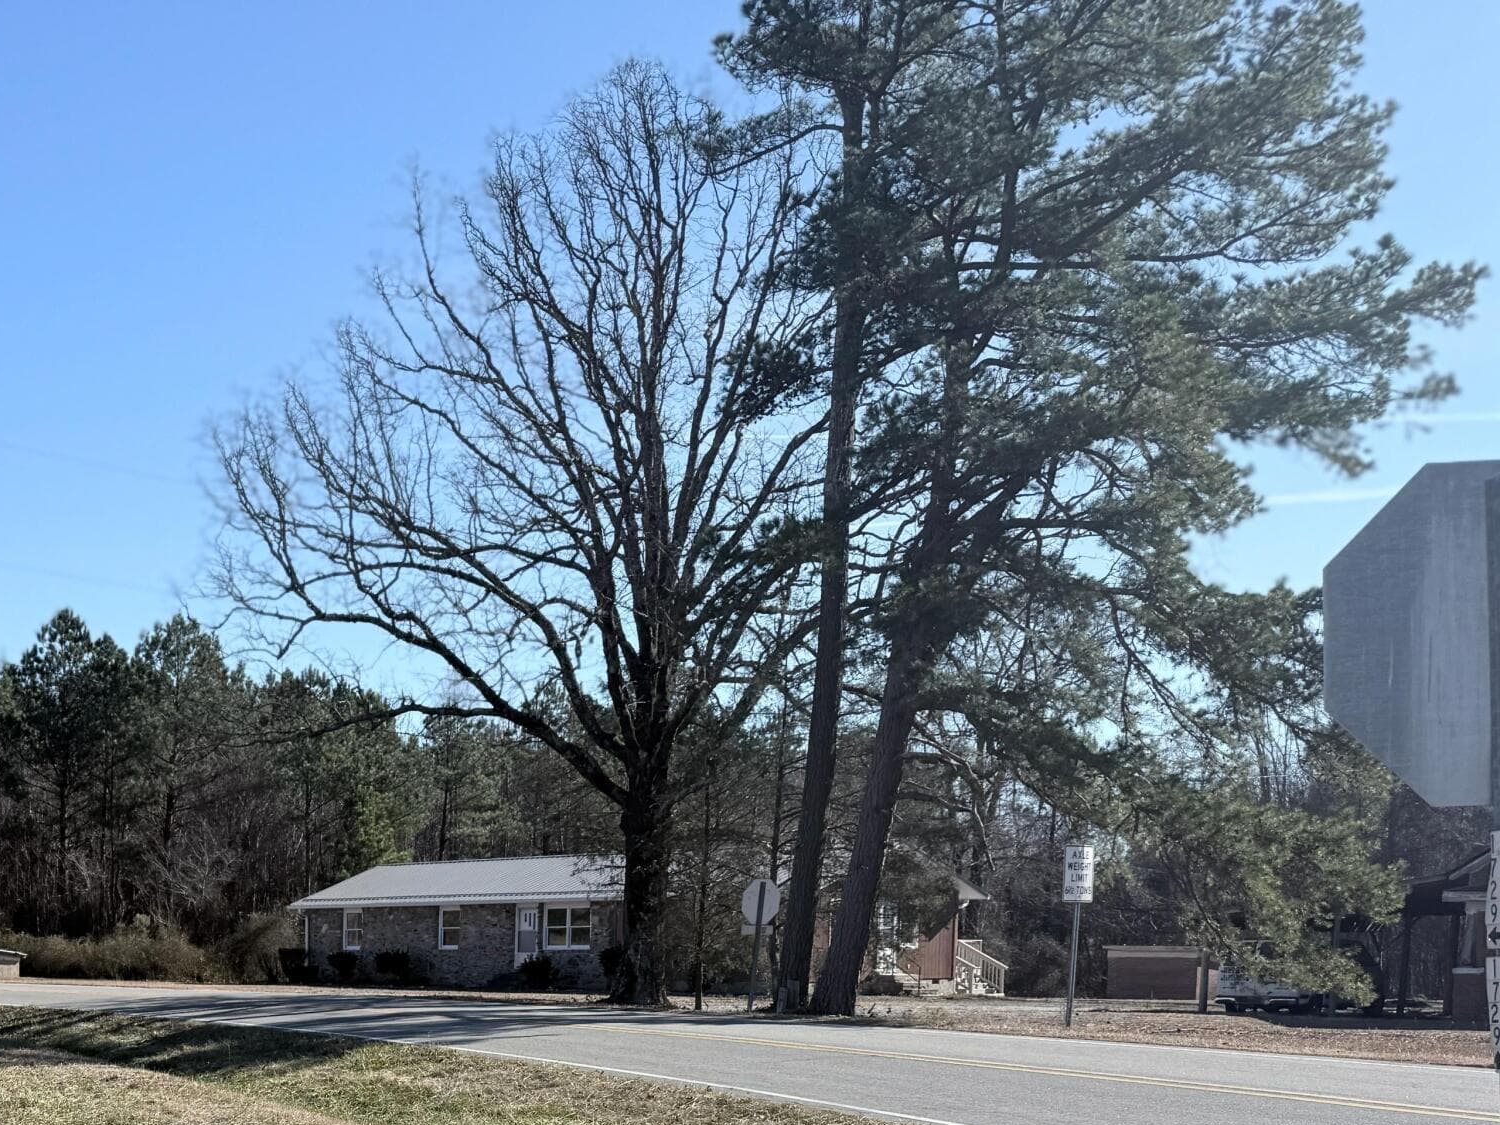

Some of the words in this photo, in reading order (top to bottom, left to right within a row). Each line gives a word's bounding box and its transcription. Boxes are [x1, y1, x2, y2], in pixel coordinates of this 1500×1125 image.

[1072, 850, 1089, 859] AXLE
[1068, 862, 1091, 871] WEIGHT
[1071, 873, 1088, 882] LIMIT
[1490, 833, 1498, 922] 1729
[1491, 959, 1500, 1046] 1729
